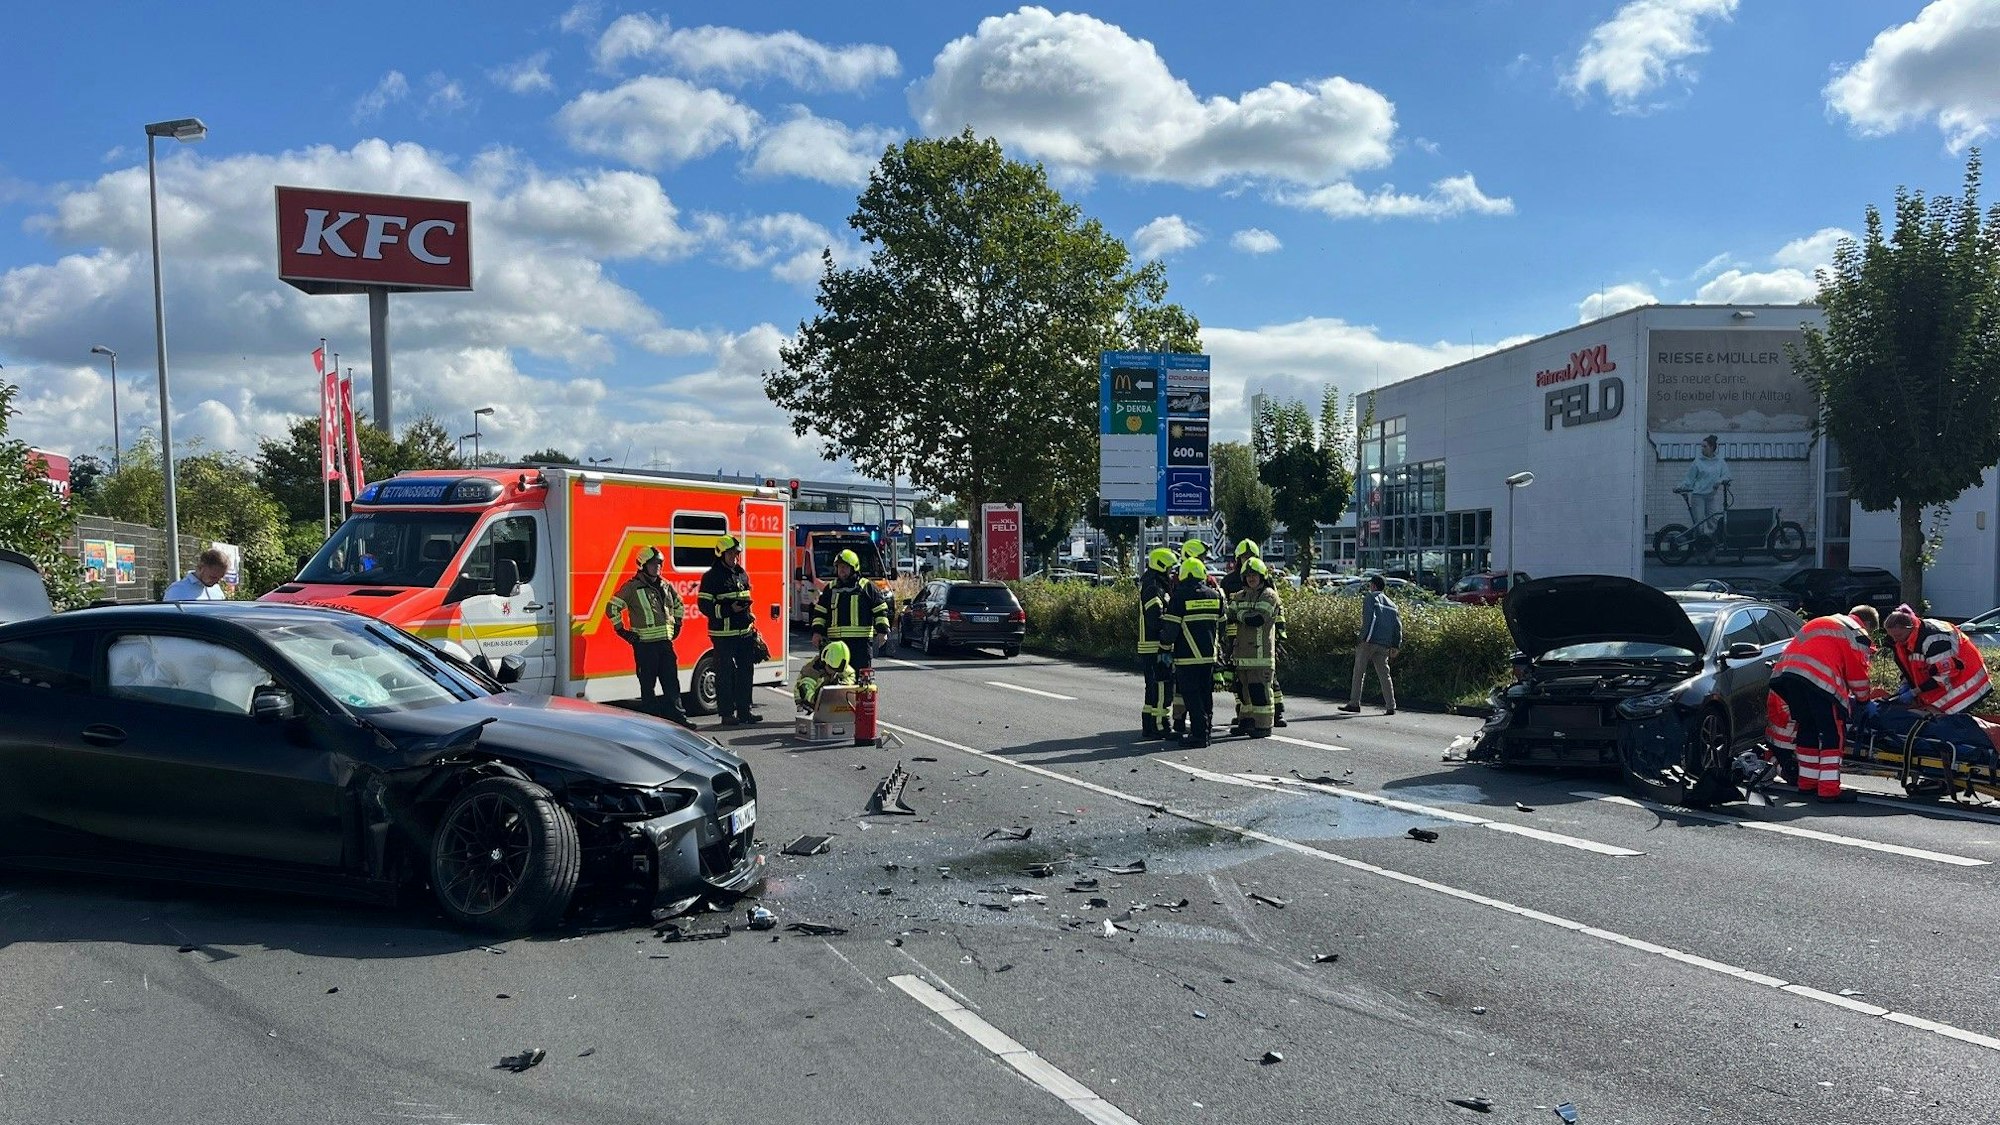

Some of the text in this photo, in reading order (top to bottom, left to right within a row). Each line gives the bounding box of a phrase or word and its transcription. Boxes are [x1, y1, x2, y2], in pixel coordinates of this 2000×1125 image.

[296, 208, 456, 266] KFC
[1658, 351, 1780, 364] RIESE & MÜLLER
[1536, 344, 1617, 388] Fahrrad XXL
[1658, 373, 1679, 384] Das
[1681, 375, 1711, 384] neue
[1656, 390, 1791, 403] So flexibel wie Ihr Alltag
[1126, 405, 1153, 413] DEKRA
[1545, 377, 1625, 431] FELD
[1173, 447, 1195, 457] 600
[381, 485, 447, 498] RETTUNGSDIENST
[760, 516, 779, 531] 112
